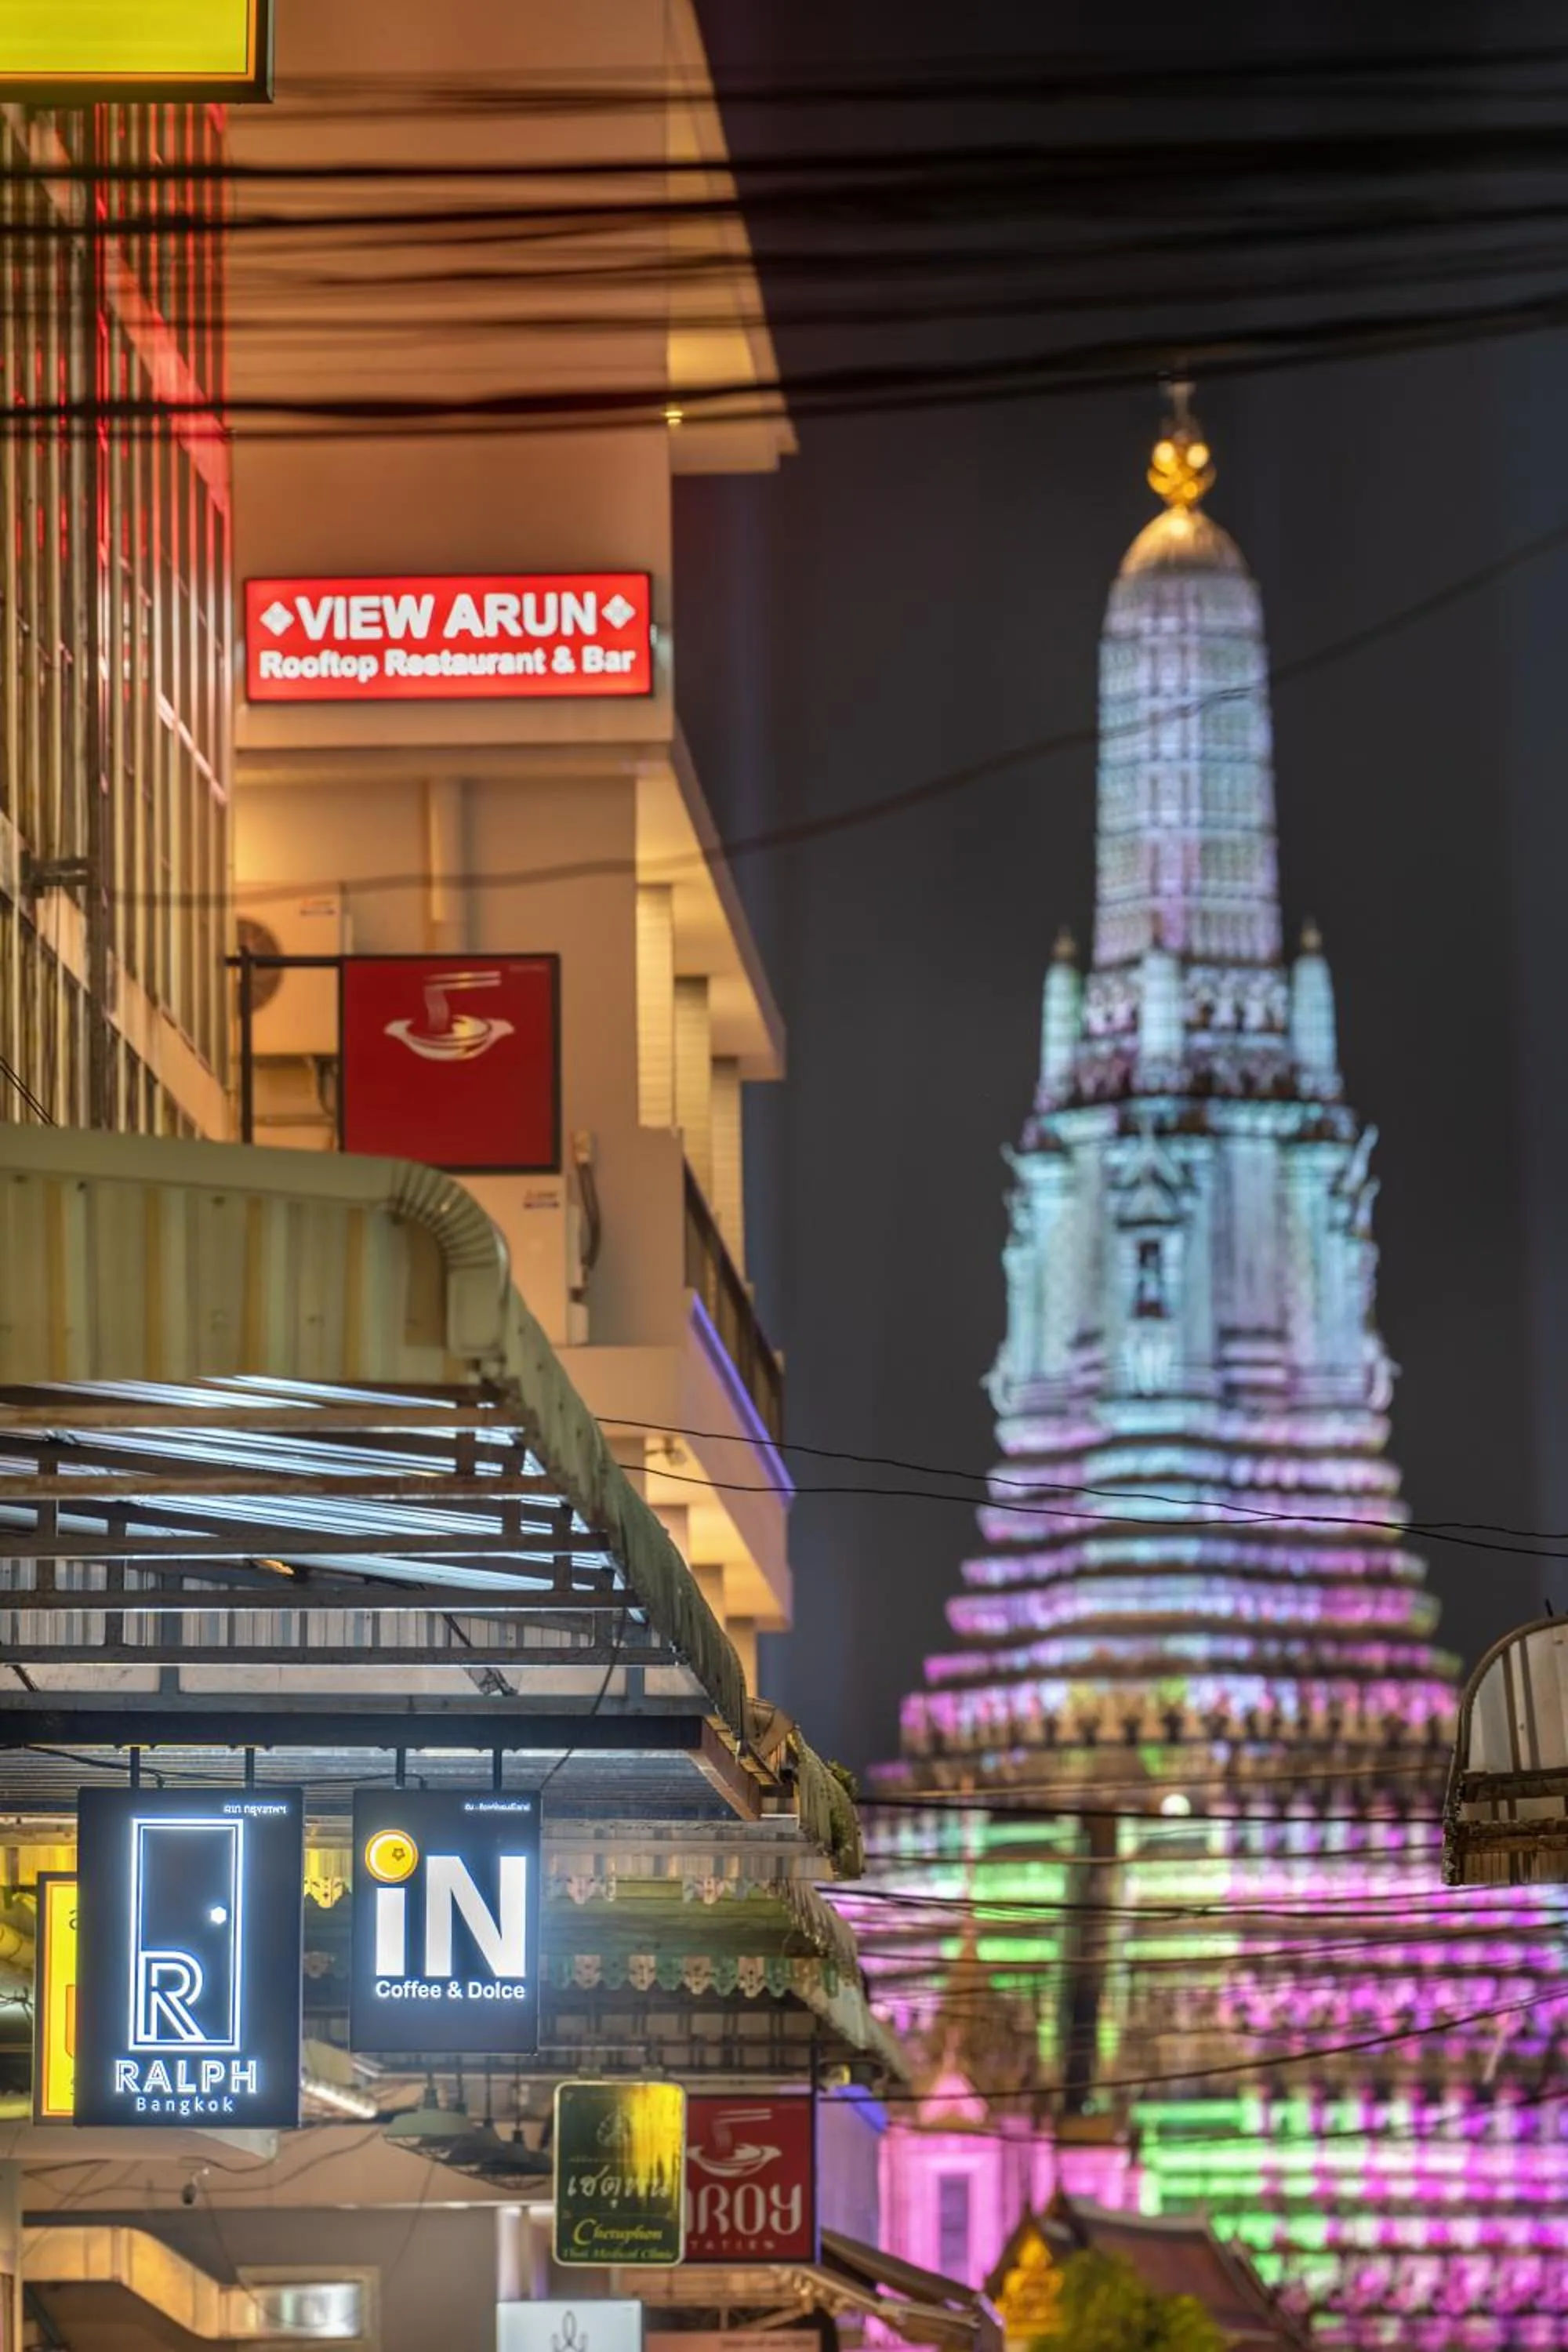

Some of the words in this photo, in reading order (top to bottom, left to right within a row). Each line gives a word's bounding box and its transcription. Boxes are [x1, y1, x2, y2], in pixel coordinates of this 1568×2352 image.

[295, 594, 434, 640] VIEW
[443, 592, 597, 638] ARUN
[259, 652, 378, 682] Rooftop
[384, 648, 546, 677] Restaurant
[551, 647, 575, 673] &
[583, 645, 636, 673] Bar
[137, 1951, 207, 2042] R
[376, 1980, 441, 1998] Coffee
[447, 1981, 463, 1998] &
[468, 1981, 526, 1998] Dolce
[115, 2060, 256, 2093] RALPH
[136, 2097, 234, 2115] Bangkok
